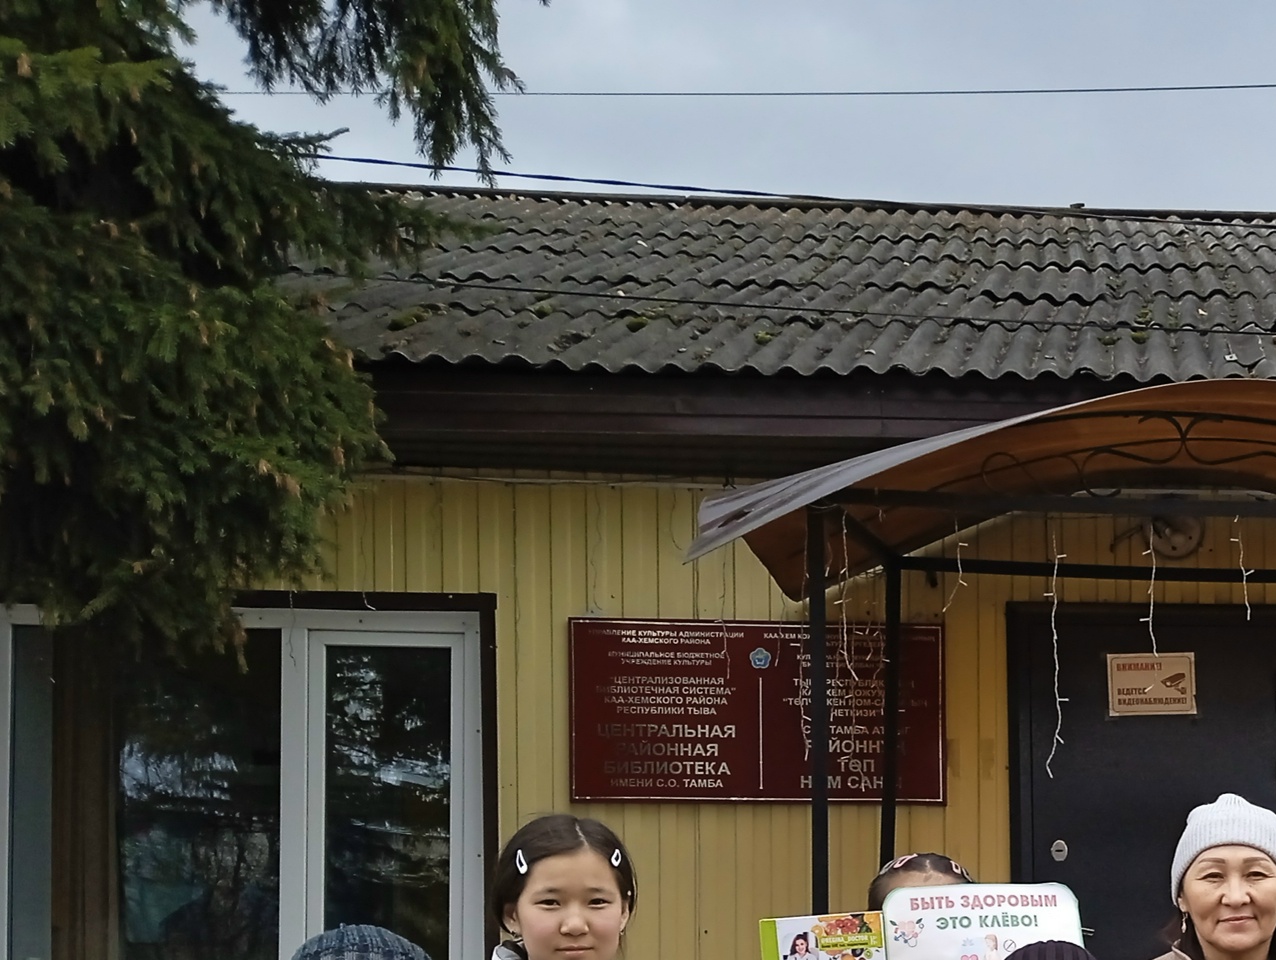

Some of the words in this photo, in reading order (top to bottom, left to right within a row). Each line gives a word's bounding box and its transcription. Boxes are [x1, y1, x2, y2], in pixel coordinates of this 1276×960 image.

[638, 630, 677, 638] КУЛЬТУРЫ
[682, 686, 736, 695] СИСТЕМА"
[604, 696, 683, 704] КАА-ХЕМСКОГО
[686, 695, 728, 705] РАЙОНА
[616, 706, 684, 715] РЕСПУБЛИКИ
[687, 707, 717, 715] ТЫВА
[597, 723, 736, 738] ЦЕНТРАЛЬНАЯ
[829, 726, 869, 735] ТАМБА
[616, 740, 719, 756] РАЙОННАЯ
[604, 760, 731, 775] БИБЛИОТЕКА
[610, 778, 653, 787] ИМЕНИ
[656, 779, 680, 787] С.О.
[683, 779, 723, 788] ТАМБА
[800, 776, 841, 789] НМ
[910, 896, 955, 911] БЫТЬ
[960, 894, 1057, 910] ЗДОРОВЫМ
[936, 915, 972, 930] ЭТО
[979, 912, 1038, 928] КЛЁВО!
